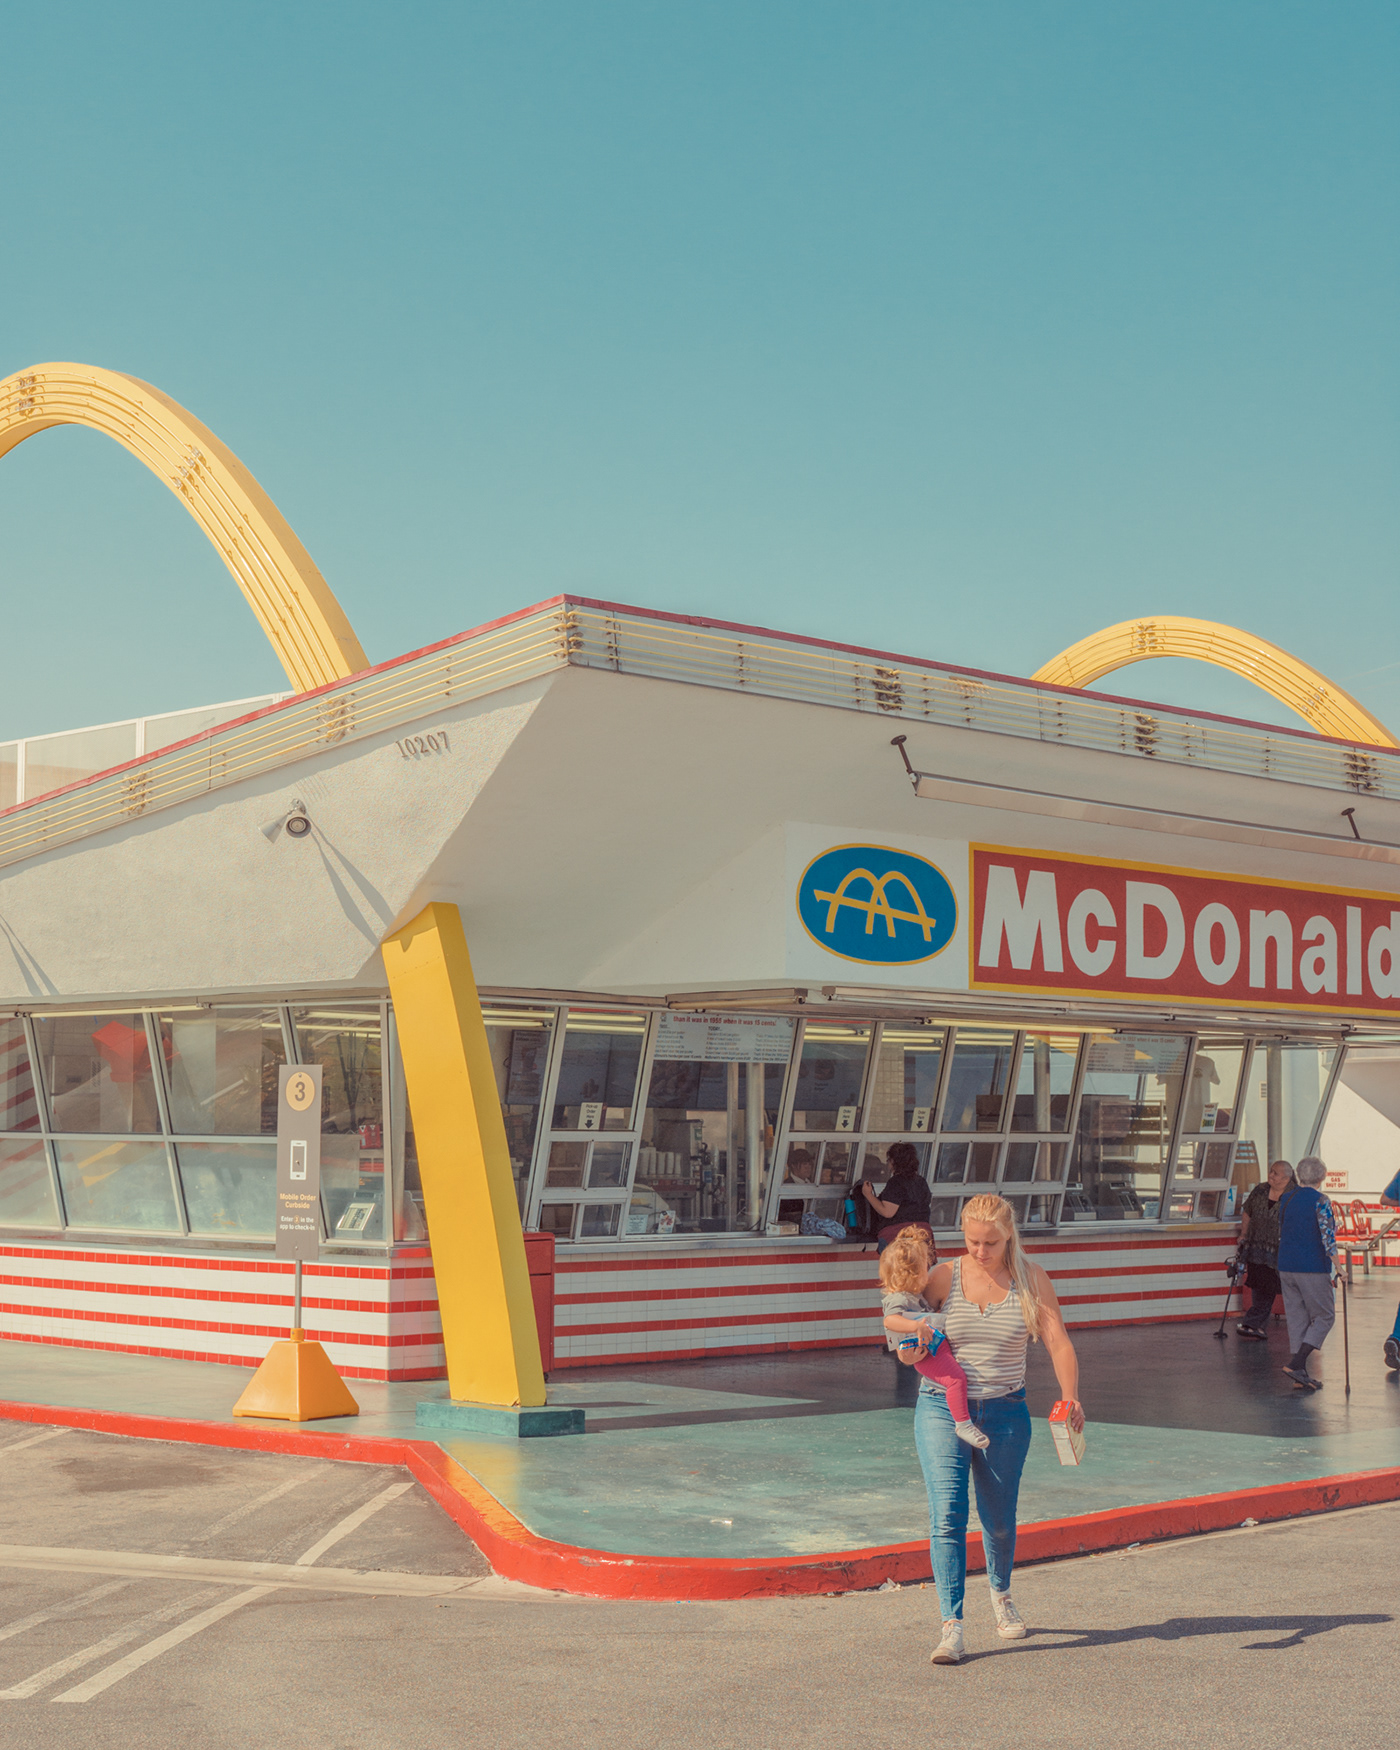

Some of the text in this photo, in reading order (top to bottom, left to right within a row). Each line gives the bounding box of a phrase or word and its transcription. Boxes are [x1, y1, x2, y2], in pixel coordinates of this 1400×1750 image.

[396, 731, 449, 758] 10207
[978, 864, 1400, 999] McDonald
[294, 1081, 306, 1102] 3
[285, 1201, 310, 1209] Curbside
